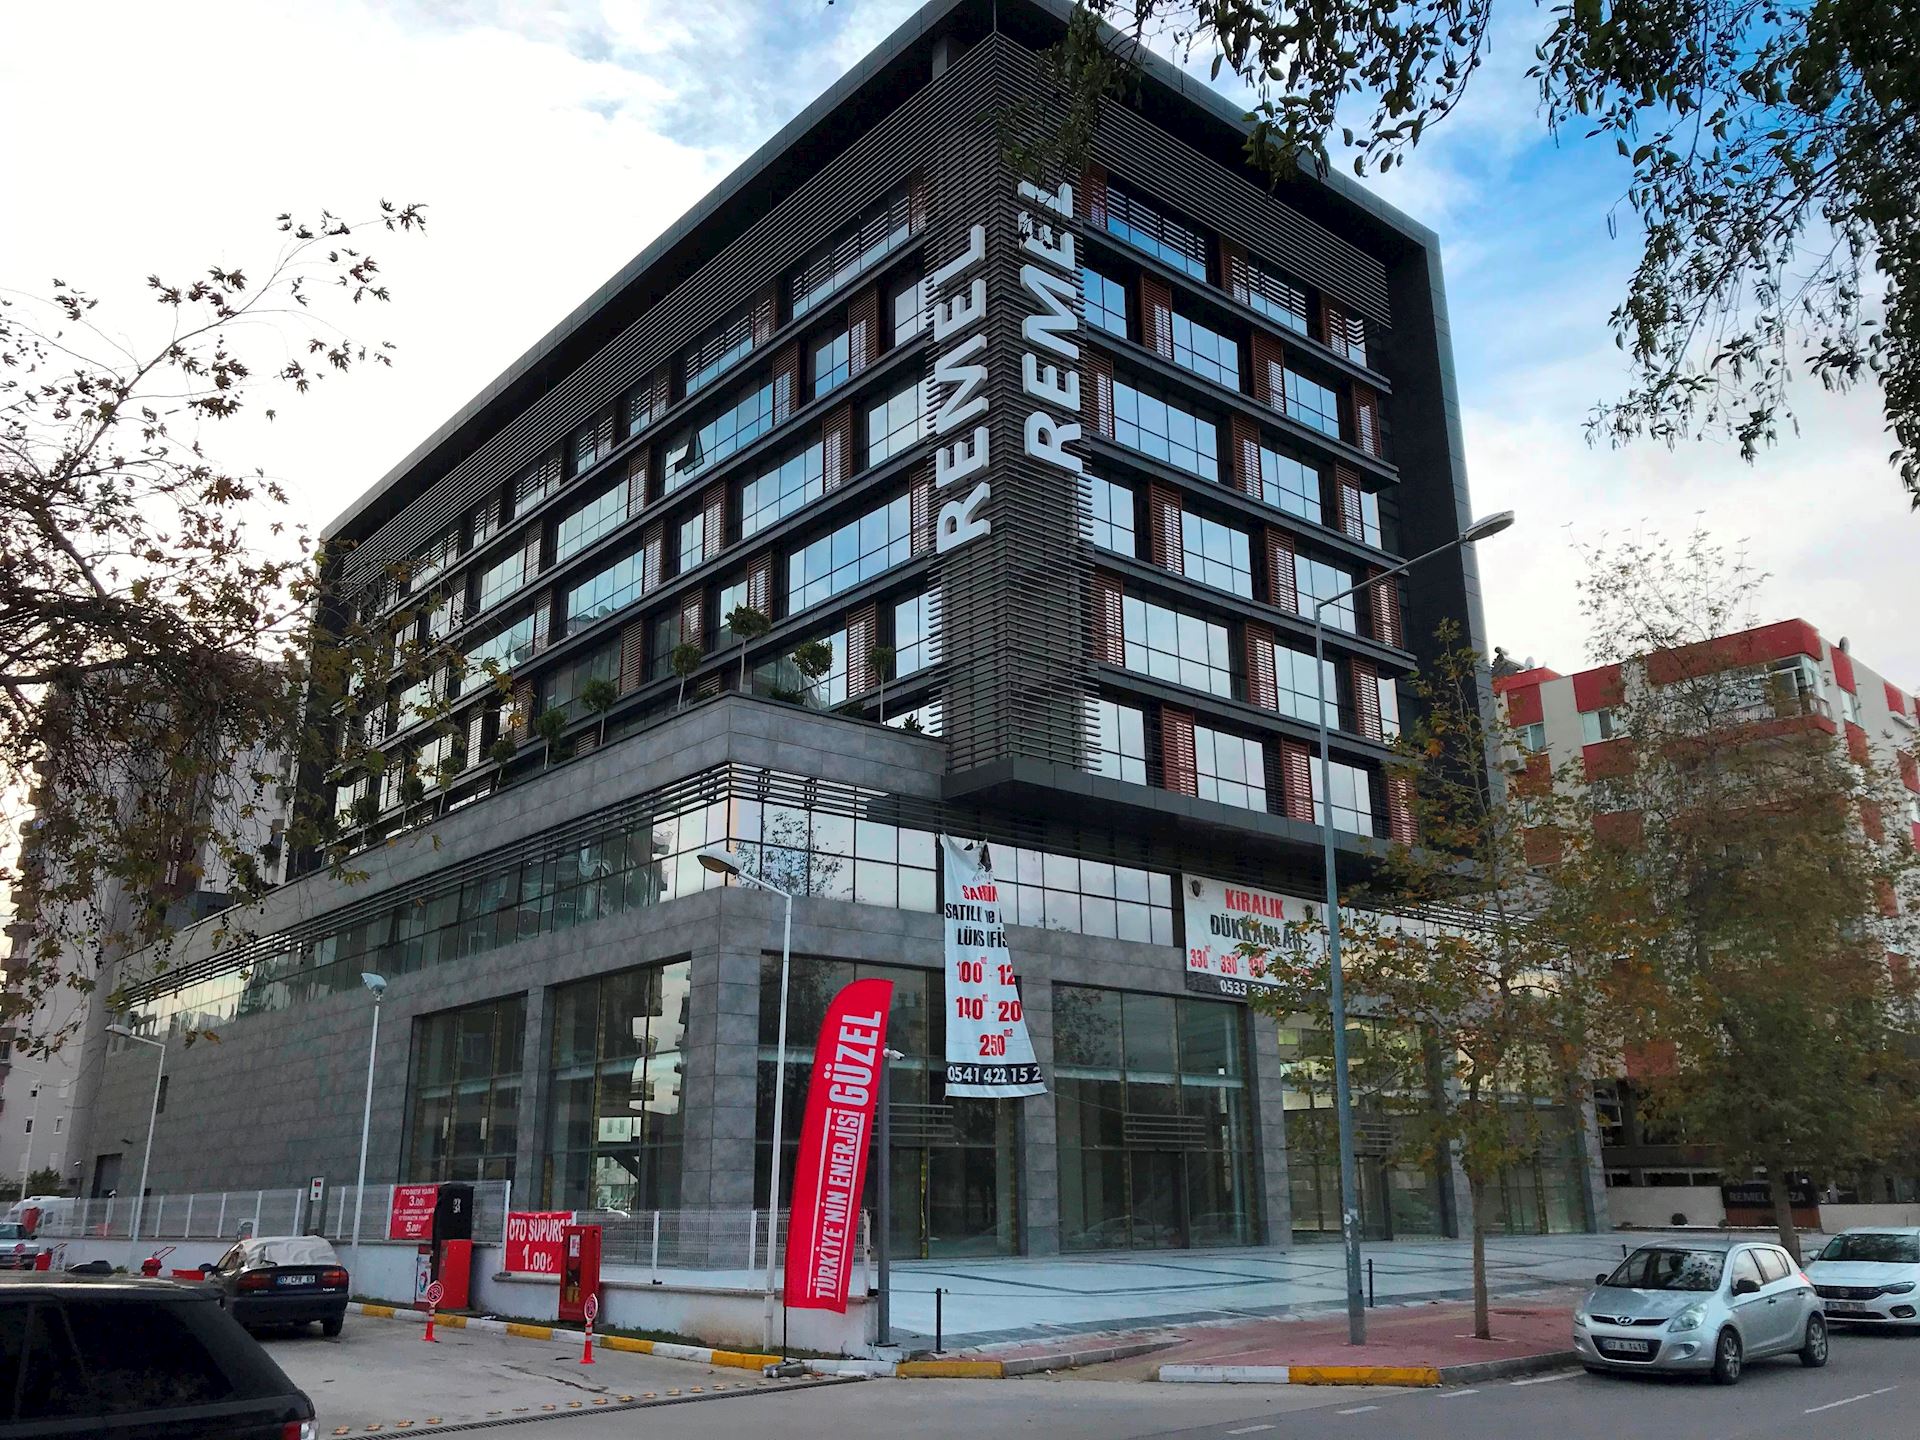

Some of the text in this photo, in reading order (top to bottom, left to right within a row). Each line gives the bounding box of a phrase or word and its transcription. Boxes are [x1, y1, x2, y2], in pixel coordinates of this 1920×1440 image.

[1017, 180, 1083, 473] REMEL
[934, 224, 991, 555] REMEL
[1220, 980, 1247, 996] 0533
[998, 1000, 1021, 1022] 20
[947, 1065, 980, 1083] 0541
[983, 1067, 1008, 1083] 422
[1011, 1067, 1029, 1083] 15
[812, 1010, 882, 1299] TÜRKİYE'NİN ENERJİSİ GÜZEL
[508, 1218, 527, 1242] OTO
